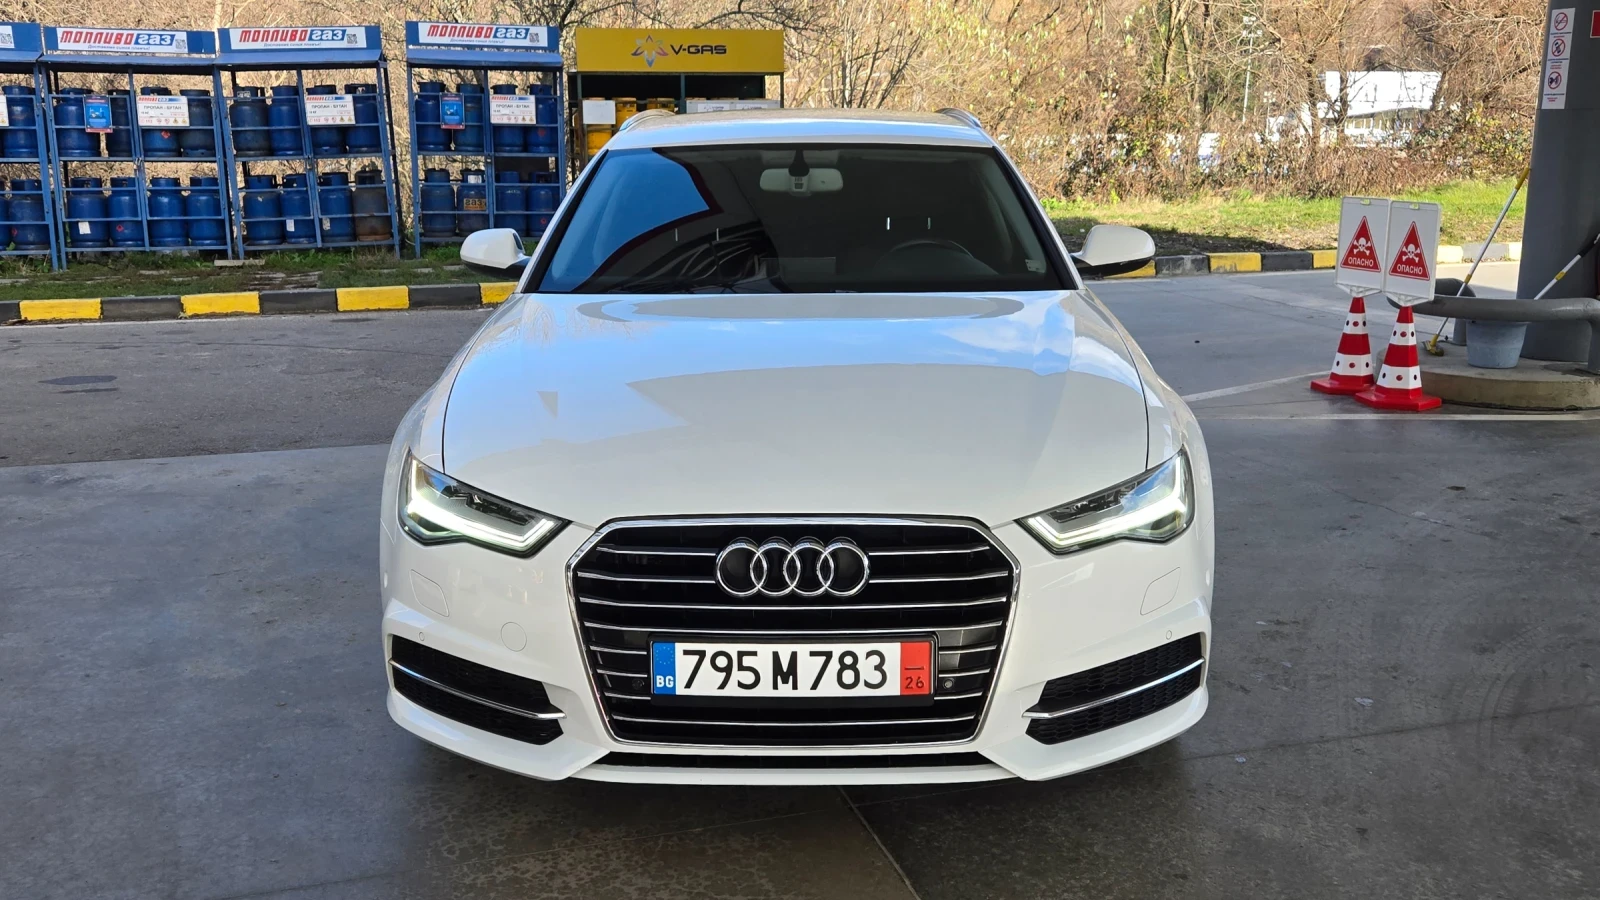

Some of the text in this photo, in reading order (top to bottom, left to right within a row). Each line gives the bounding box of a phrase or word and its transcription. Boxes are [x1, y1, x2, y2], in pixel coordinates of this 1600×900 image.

[670, 44, 727, 55] V-GAS
[1348, 256, 1374, 267] ОПАСНО
[1396, 263, 1423, 275] ОПАСНО
[682, 649, 761, 690] 795
[809, 651, 888, 690] 783
[656, 675, 674, 688] BG
[905, 676, 925, 690] 26
